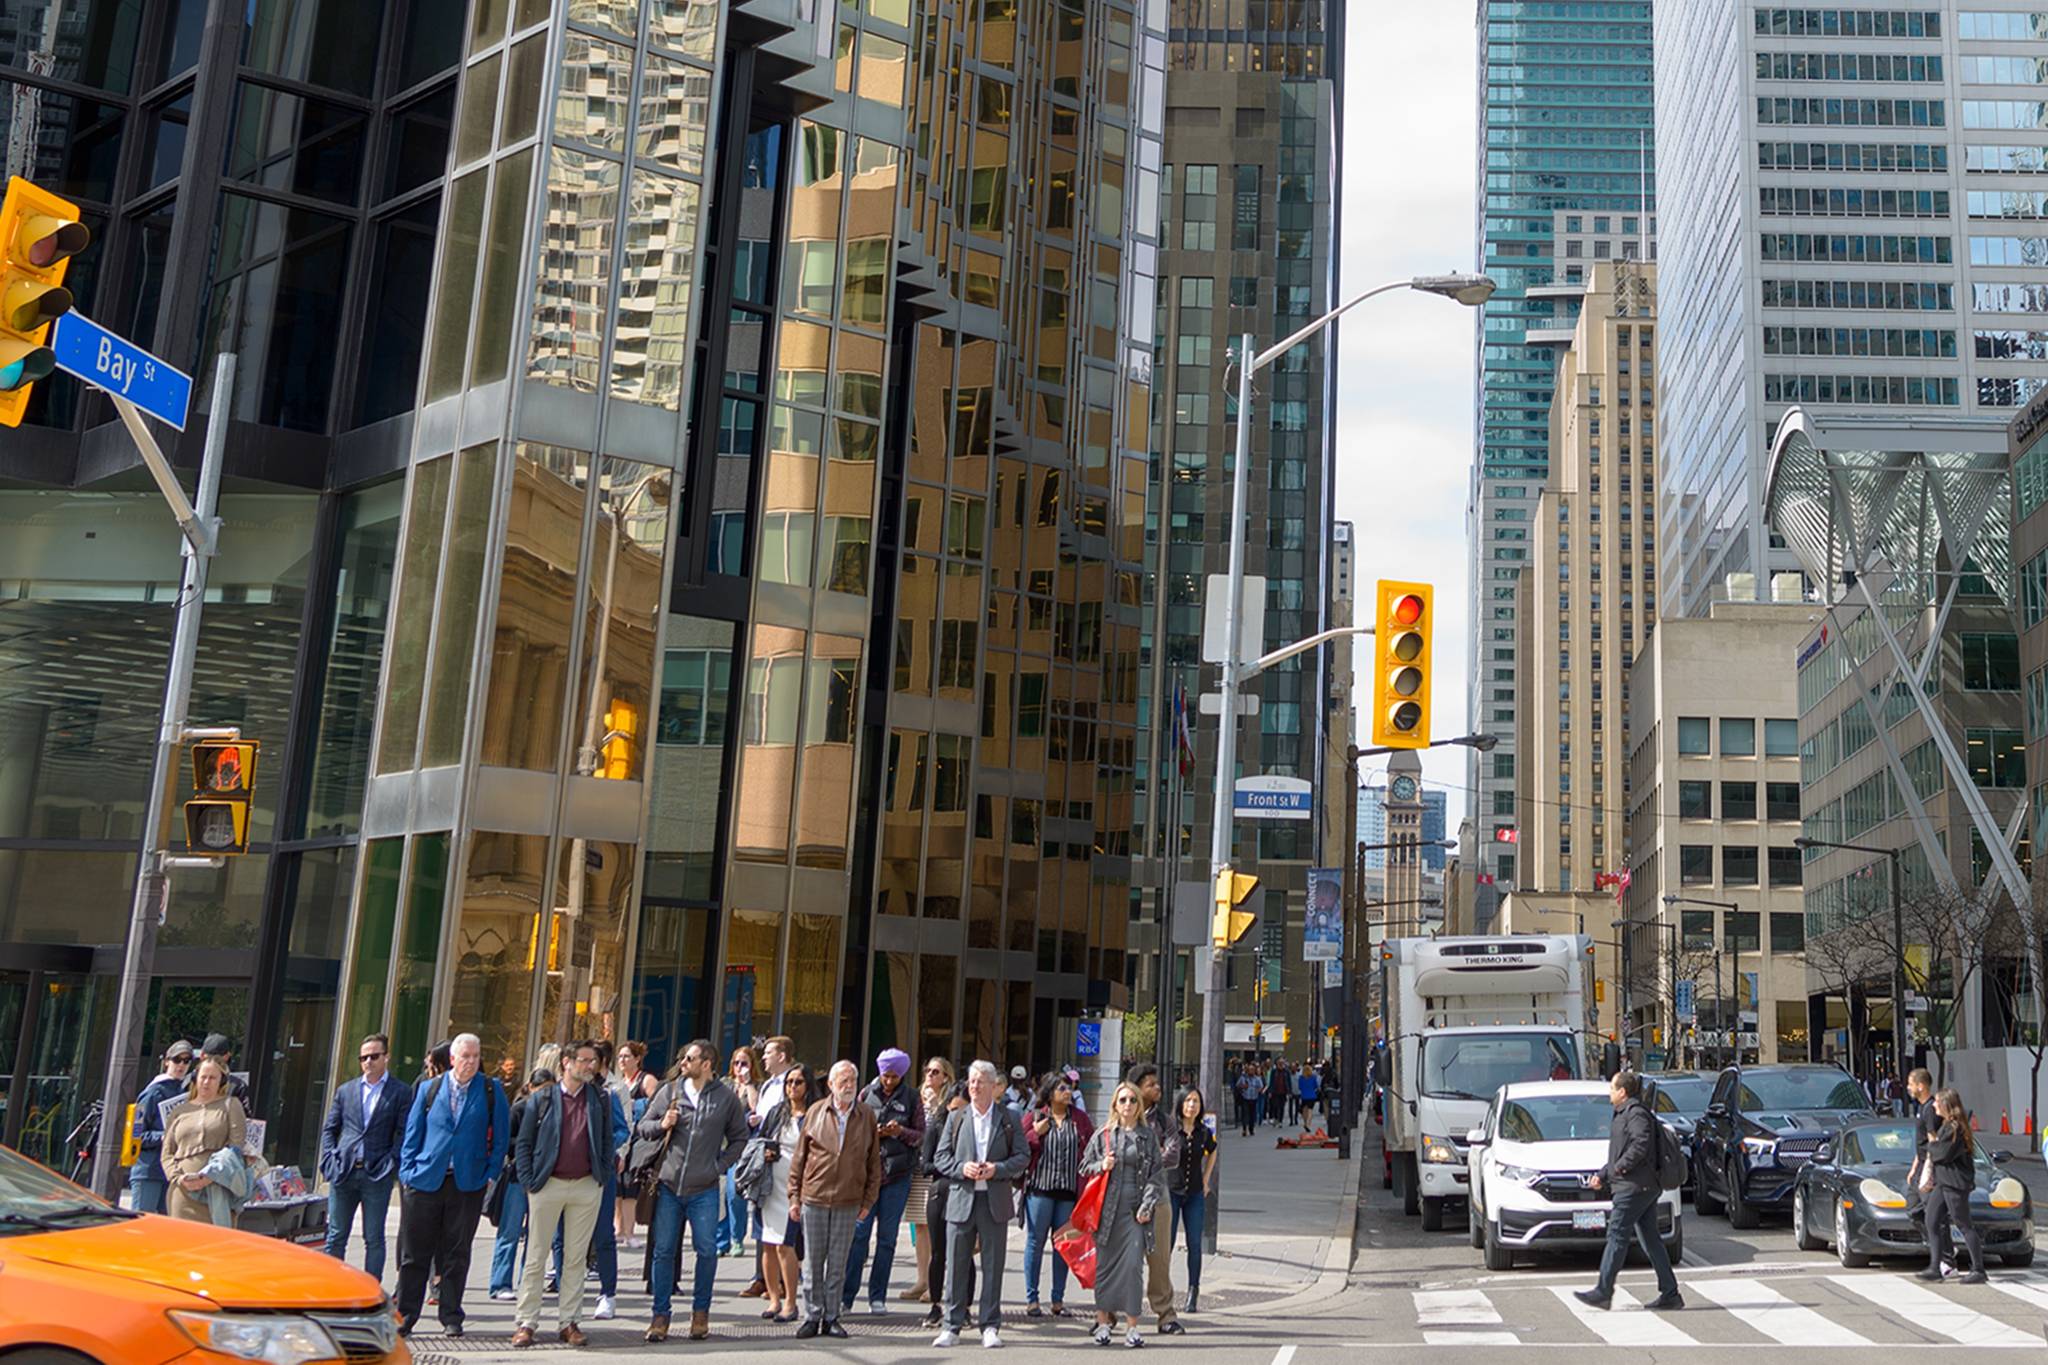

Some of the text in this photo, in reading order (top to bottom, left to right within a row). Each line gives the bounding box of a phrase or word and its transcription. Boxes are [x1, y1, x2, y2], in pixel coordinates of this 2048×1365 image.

[96, 336, 156, 394] Bay St
[1247, 793, 1300, 807] Front St W
[1307, 872, 1317, 917] CONNECT
[1078, 1045, 1098, 1054] RBC
